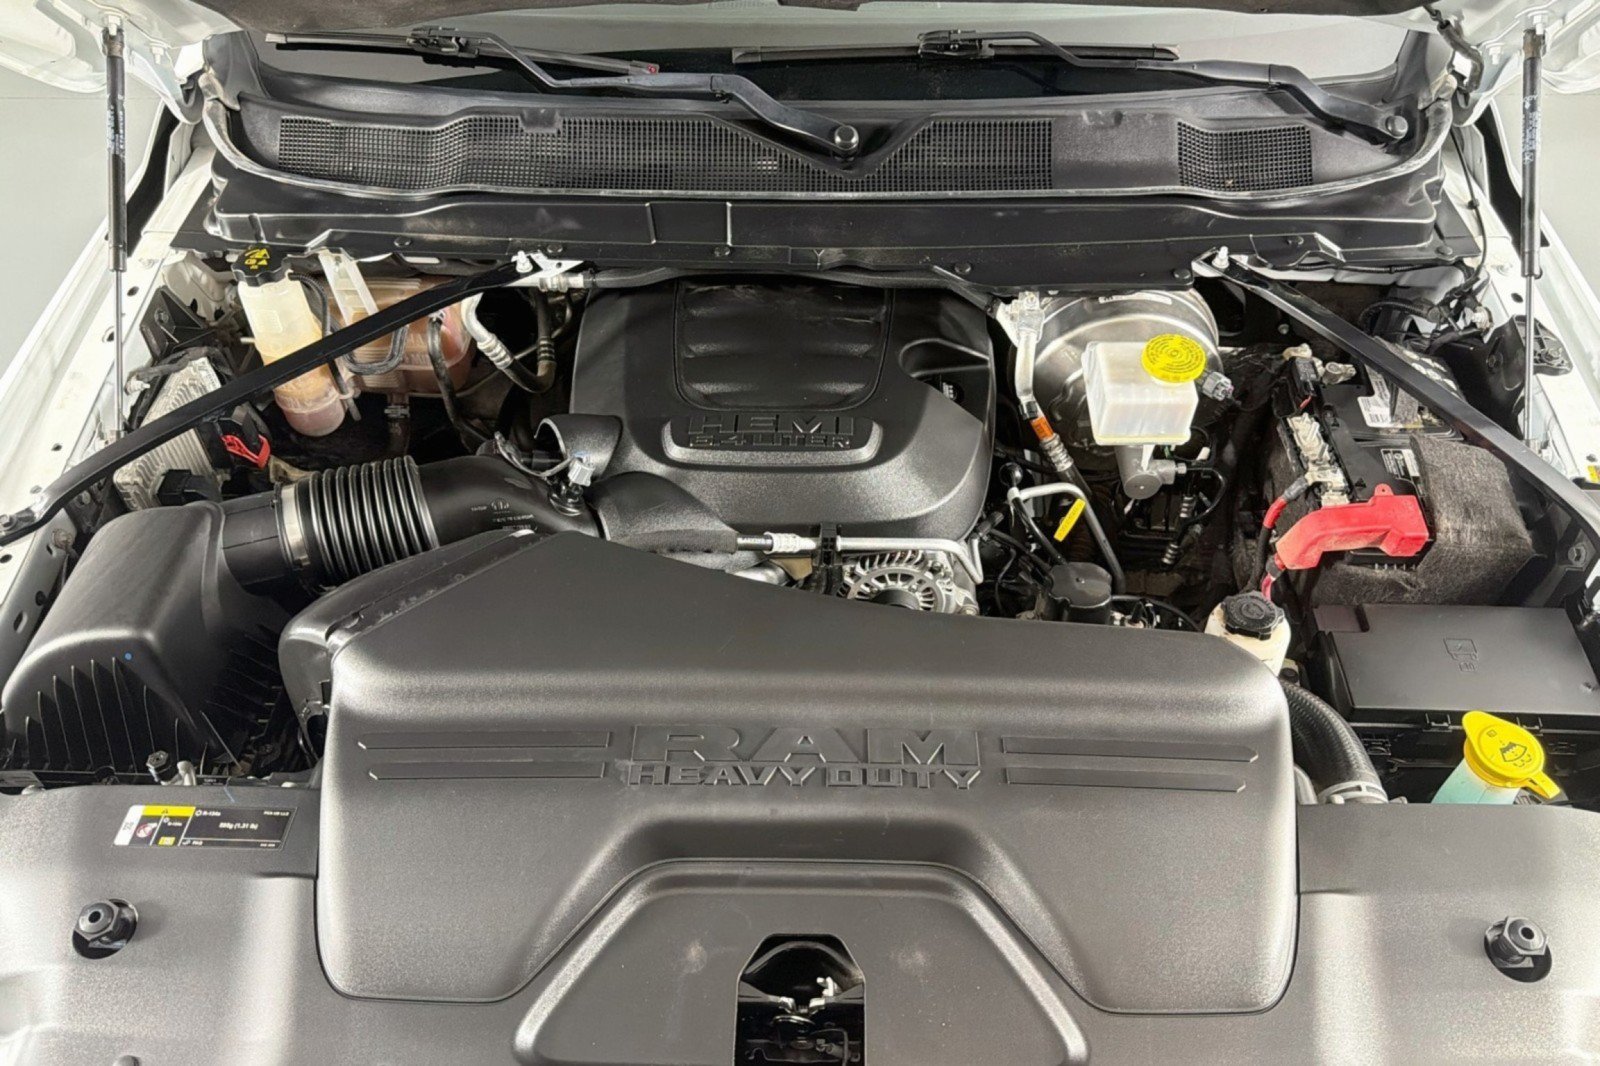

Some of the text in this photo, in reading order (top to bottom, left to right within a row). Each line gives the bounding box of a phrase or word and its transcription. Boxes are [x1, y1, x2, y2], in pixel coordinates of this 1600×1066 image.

[688, 414, 853, 435] HEMI
[630, 724, 981, 766] RAM
[627, 764, 981, 788] HEAVY DUTY
